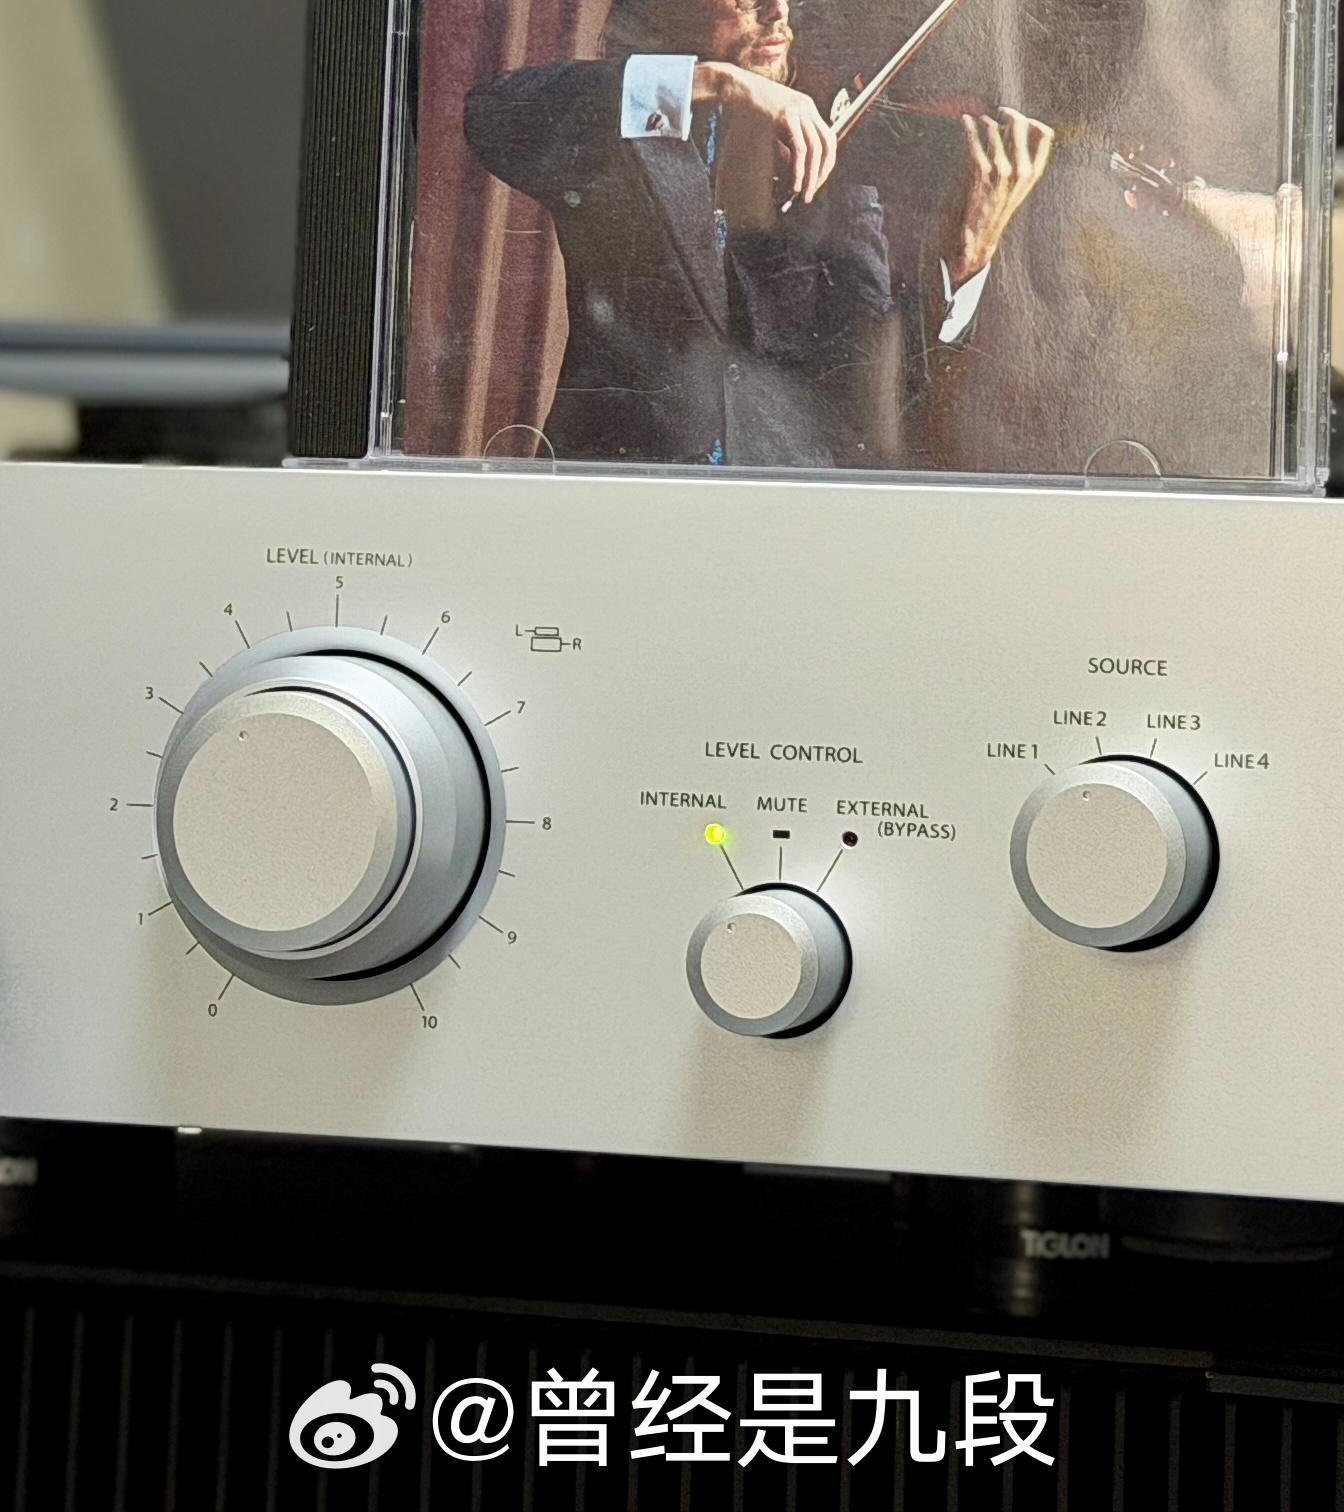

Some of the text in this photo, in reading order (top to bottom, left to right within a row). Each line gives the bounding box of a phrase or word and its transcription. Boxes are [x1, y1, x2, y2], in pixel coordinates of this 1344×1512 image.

[266, 547, 413, 569] LEVEL (INTERNAL)
[335, 575, 344, 590] 5
[223, 602, 234, 617] 4
[440, 610, 451, 624] 6
[515, 623, 523, 637] L
[572, 637, 582, 651] R
[1087, 657, 1168, 677] SOURCE
[144, 686, 154, 700] 3
[516, 700, 526, 715] 7
[705, 741, 864, 764] LEVEL CONTROL
[109, 797, 119, 812] 2
[640, 790, 727, 810] INTERNAL
[756, 795, 808, 814] MUTE
[836, 799, 929, 820] EXTERNAL
[541, 816, 552, 831] 8
[877, 820, 957, 842] (BYPASS)
[507, 930, 518, 945] 9
[207, 1003, 218, 1018] 0
[421, 1015, 438, 1030] 10
